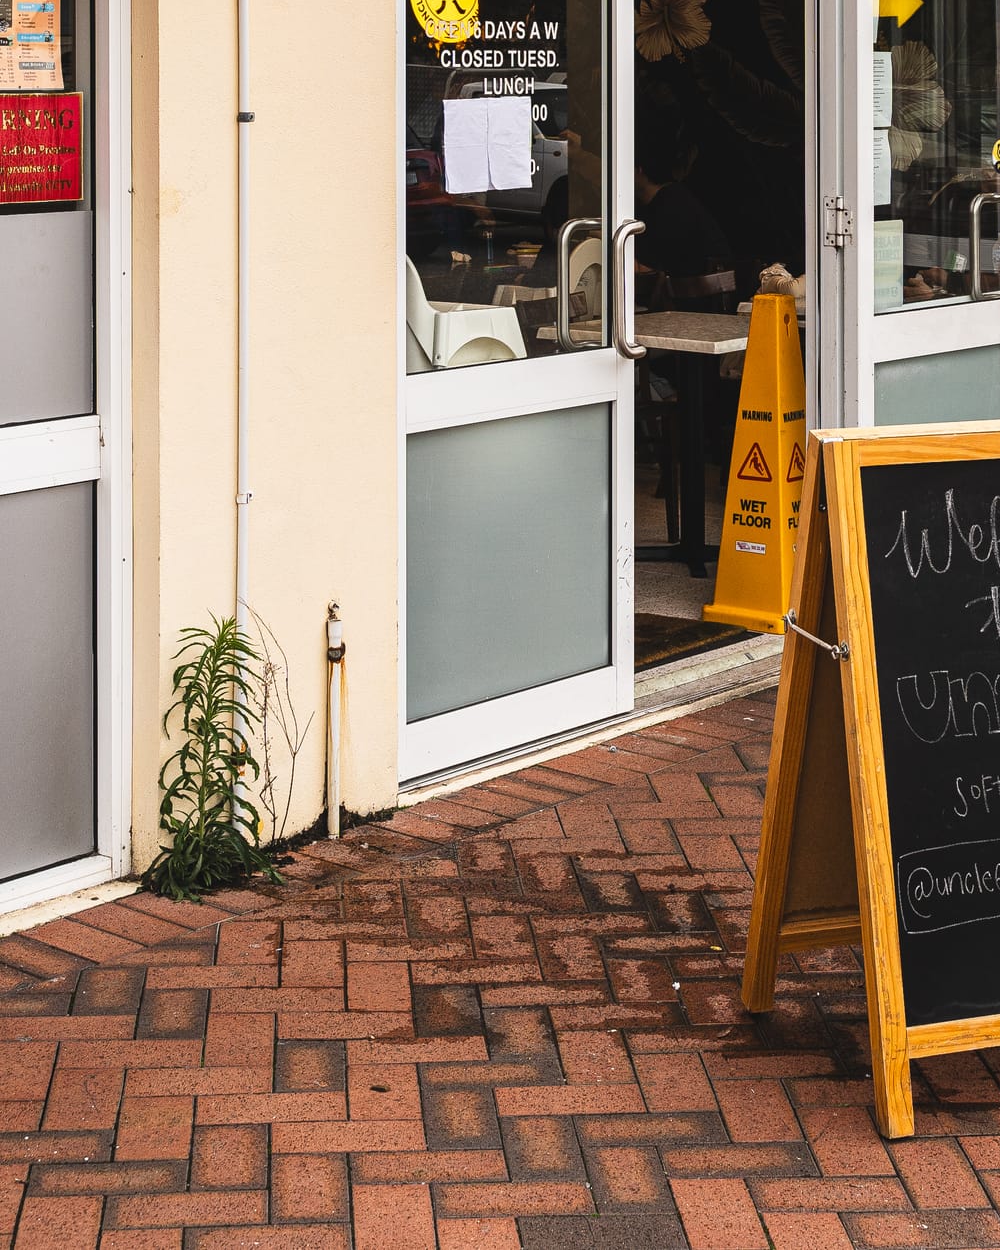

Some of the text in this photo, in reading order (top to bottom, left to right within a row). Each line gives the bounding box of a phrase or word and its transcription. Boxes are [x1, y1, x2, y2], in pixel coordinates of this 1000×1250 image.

[425, 20, 471, 39] OPEN
[473, 20, 482, 39] 6
[484, 21, 526, 39] DAYS
[529, 21, 541, 40] A
[440, 49, 504, 68] CLOSED
[483, 77, 535, 95] LUNCH
[742, 410, 773, 423] WARNING
[740, 499, 767, 514] WET
[732, 513, 772, 530] FLOOR
